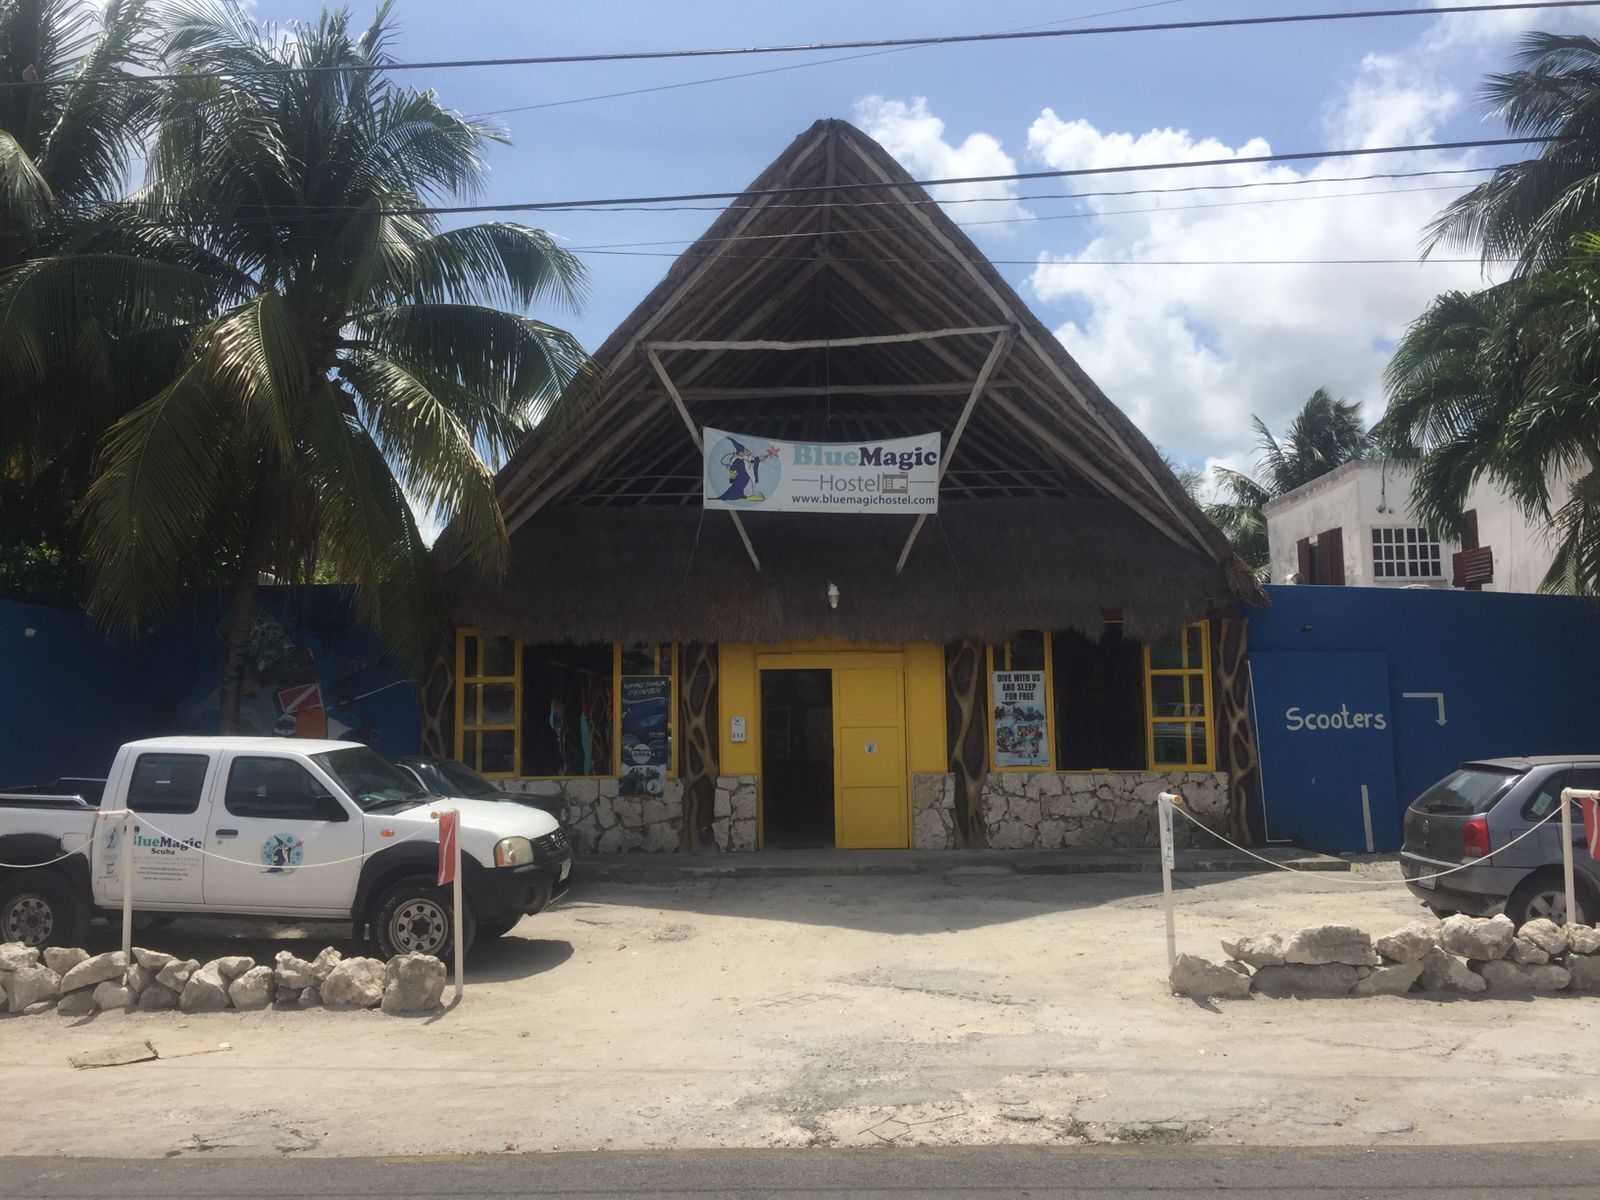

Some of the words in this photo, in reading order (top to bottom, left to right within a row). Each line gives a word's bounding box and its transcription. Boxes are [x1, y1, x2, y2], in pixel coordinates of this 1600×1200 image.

[792, 444, 937, 470] BlueMagic
[819, 474, 880, 492] Hostel
[792, 494, 935, 505] www.bluemagichostel.com
[997, 674, 1012, 682] DIVE
[1013, 674, 1030, 682] WITH
[1032, 674, 1040, 682] US
[1002, 683, 1015, 691] AND
[1017, 683, 1037, 691] SLEEP
[1005, 692, 1017, 701] FOR
[1019, 692, 1034, 701] FREE
[1285, 703, 1387, 731] Scooters
[151, 848, 176, 856] Scuba
